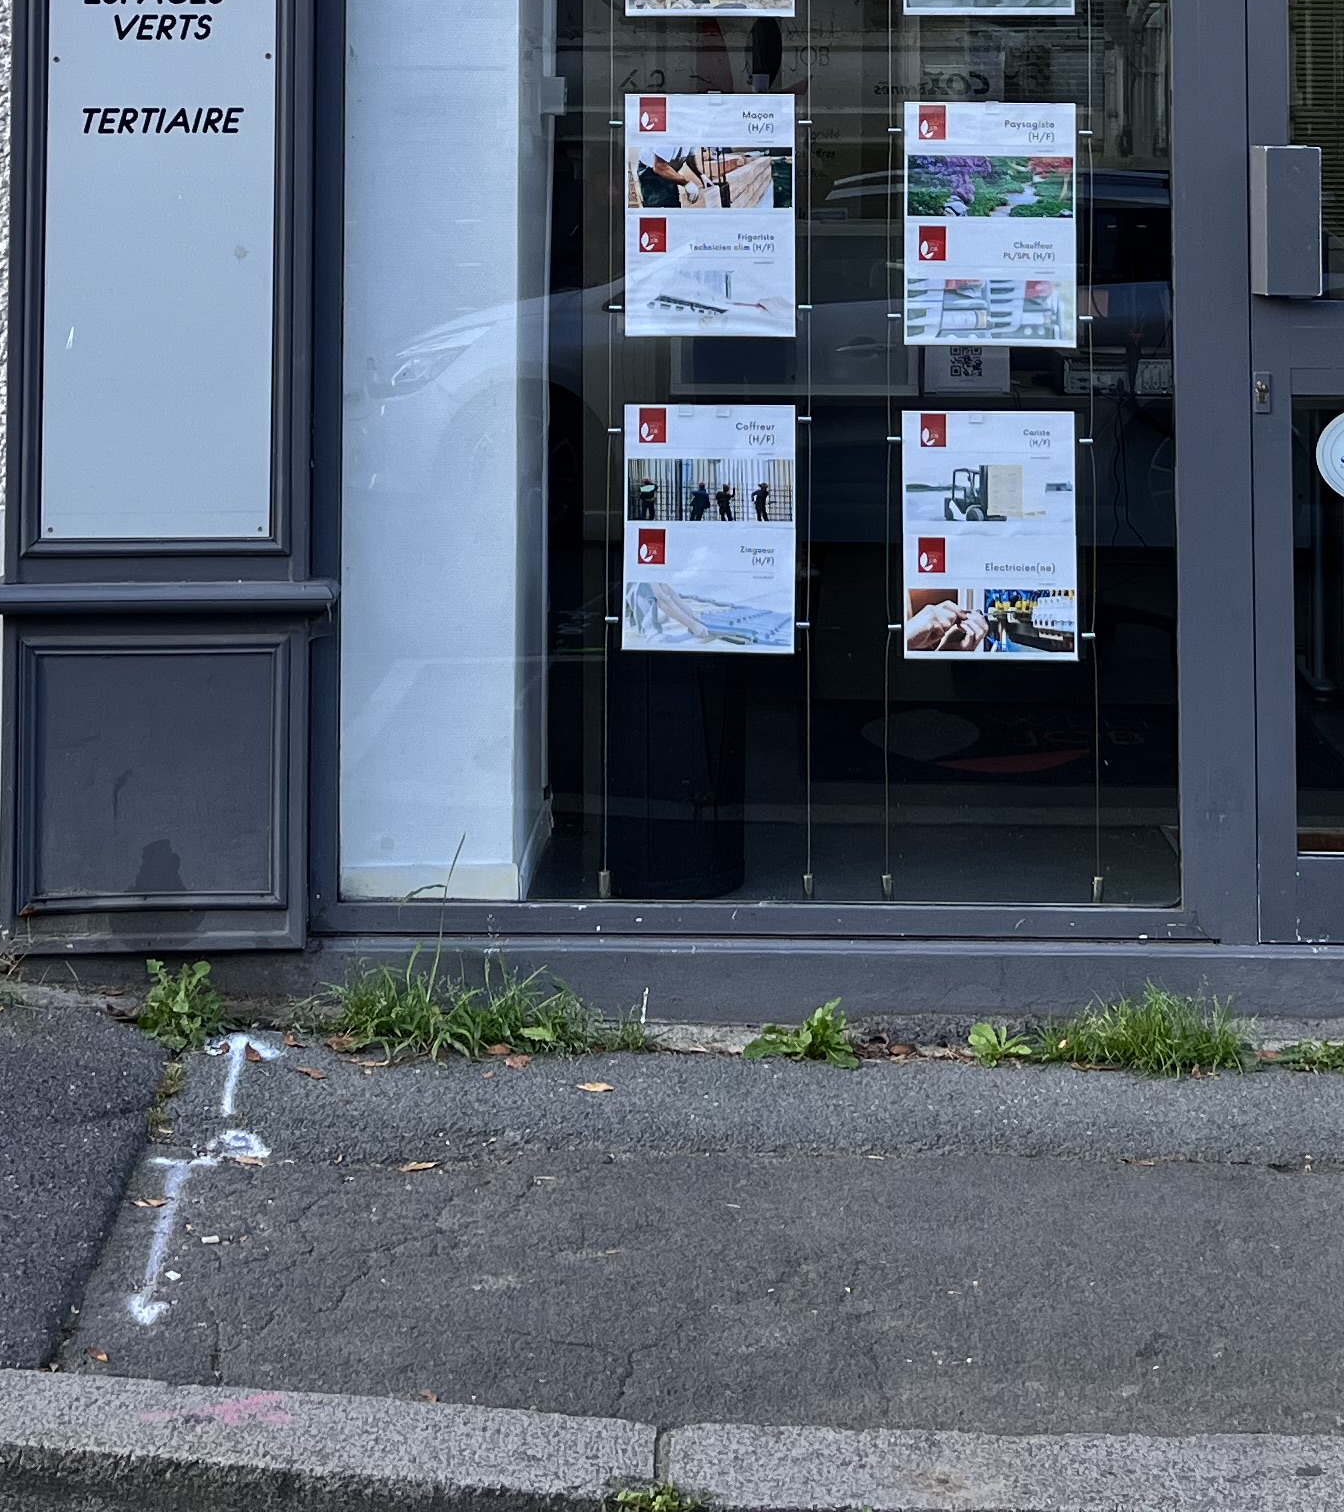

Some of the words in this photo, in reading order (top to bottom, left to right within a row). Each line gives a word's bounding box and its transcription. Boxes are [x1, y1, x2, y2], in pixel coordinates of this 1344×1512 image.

[114, 14, 213, 41] VERTS
[82, 107, 245, 134] TERTIAIRE
[742, 111, 775, 121] Maçon
[748, 122, 775, 133] (H/F)
[1004, 119, 1055, 131] Paysagiste
[1028, 131, 1055, 143] (H/F)
[752, 243, 775, 253] (H/F)
[1032, 251, 1055, 262] (H/F)
[736, 422, 775, 431] Coffreur
[748, 434, 775, 445] (H/F)
